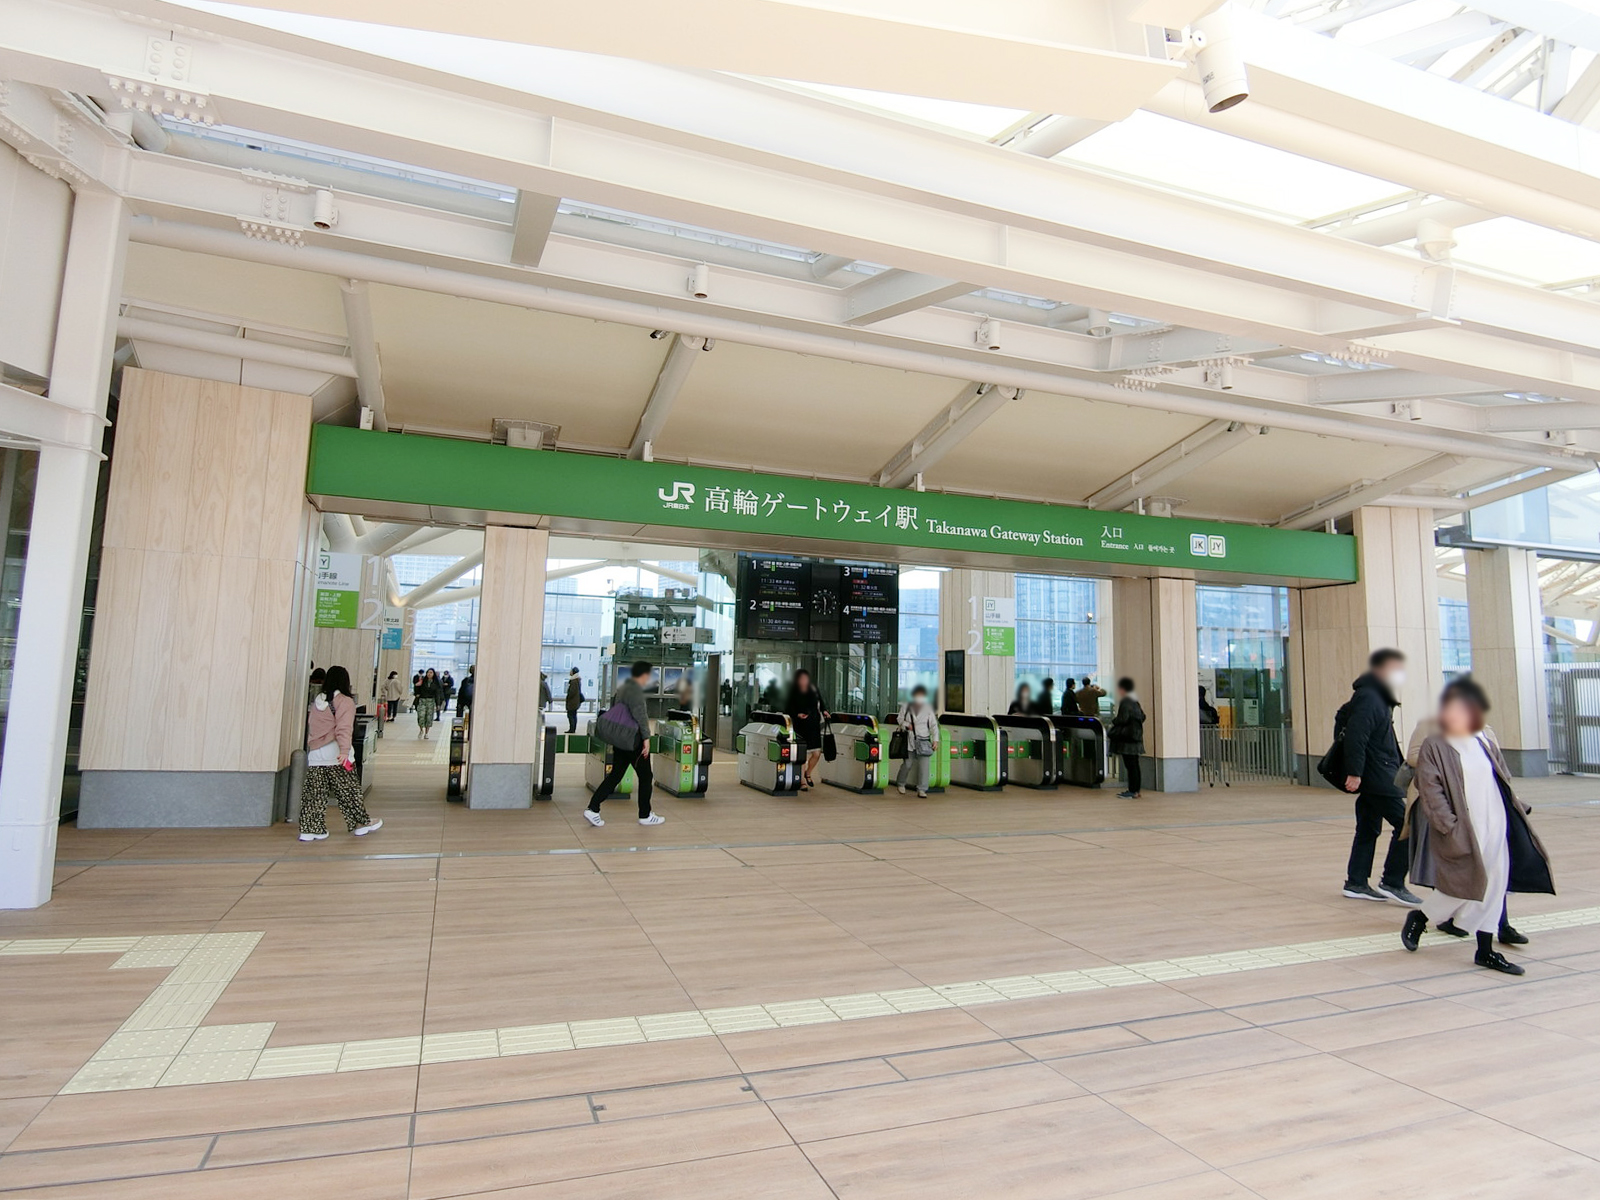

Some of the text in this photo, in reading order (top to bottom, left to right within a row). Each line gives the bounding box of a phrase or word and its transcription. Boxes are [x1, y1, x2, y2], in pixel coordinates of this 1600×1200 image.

[658, 481, 695, 503] JR
[704, 486, 919, 530] 高輪ゲートウェイ駅
[926, 518, 1084, 547] Takanawa Gateway Station
[1100, 525, 1122, 539] 入口
[1101, 540, 1129, 550] Entrance
[751, 559, 757, 570] 1
[843, 566, 850, 576] 3
[749, 599, 757, 610] 2
[842, 605, 850, 615] 4
[968, 596, 977, 620] 1
[360, 598, 383, 630] 2
[967, 630, 982, 655] 2
[985, 640, 991, 650] 2
